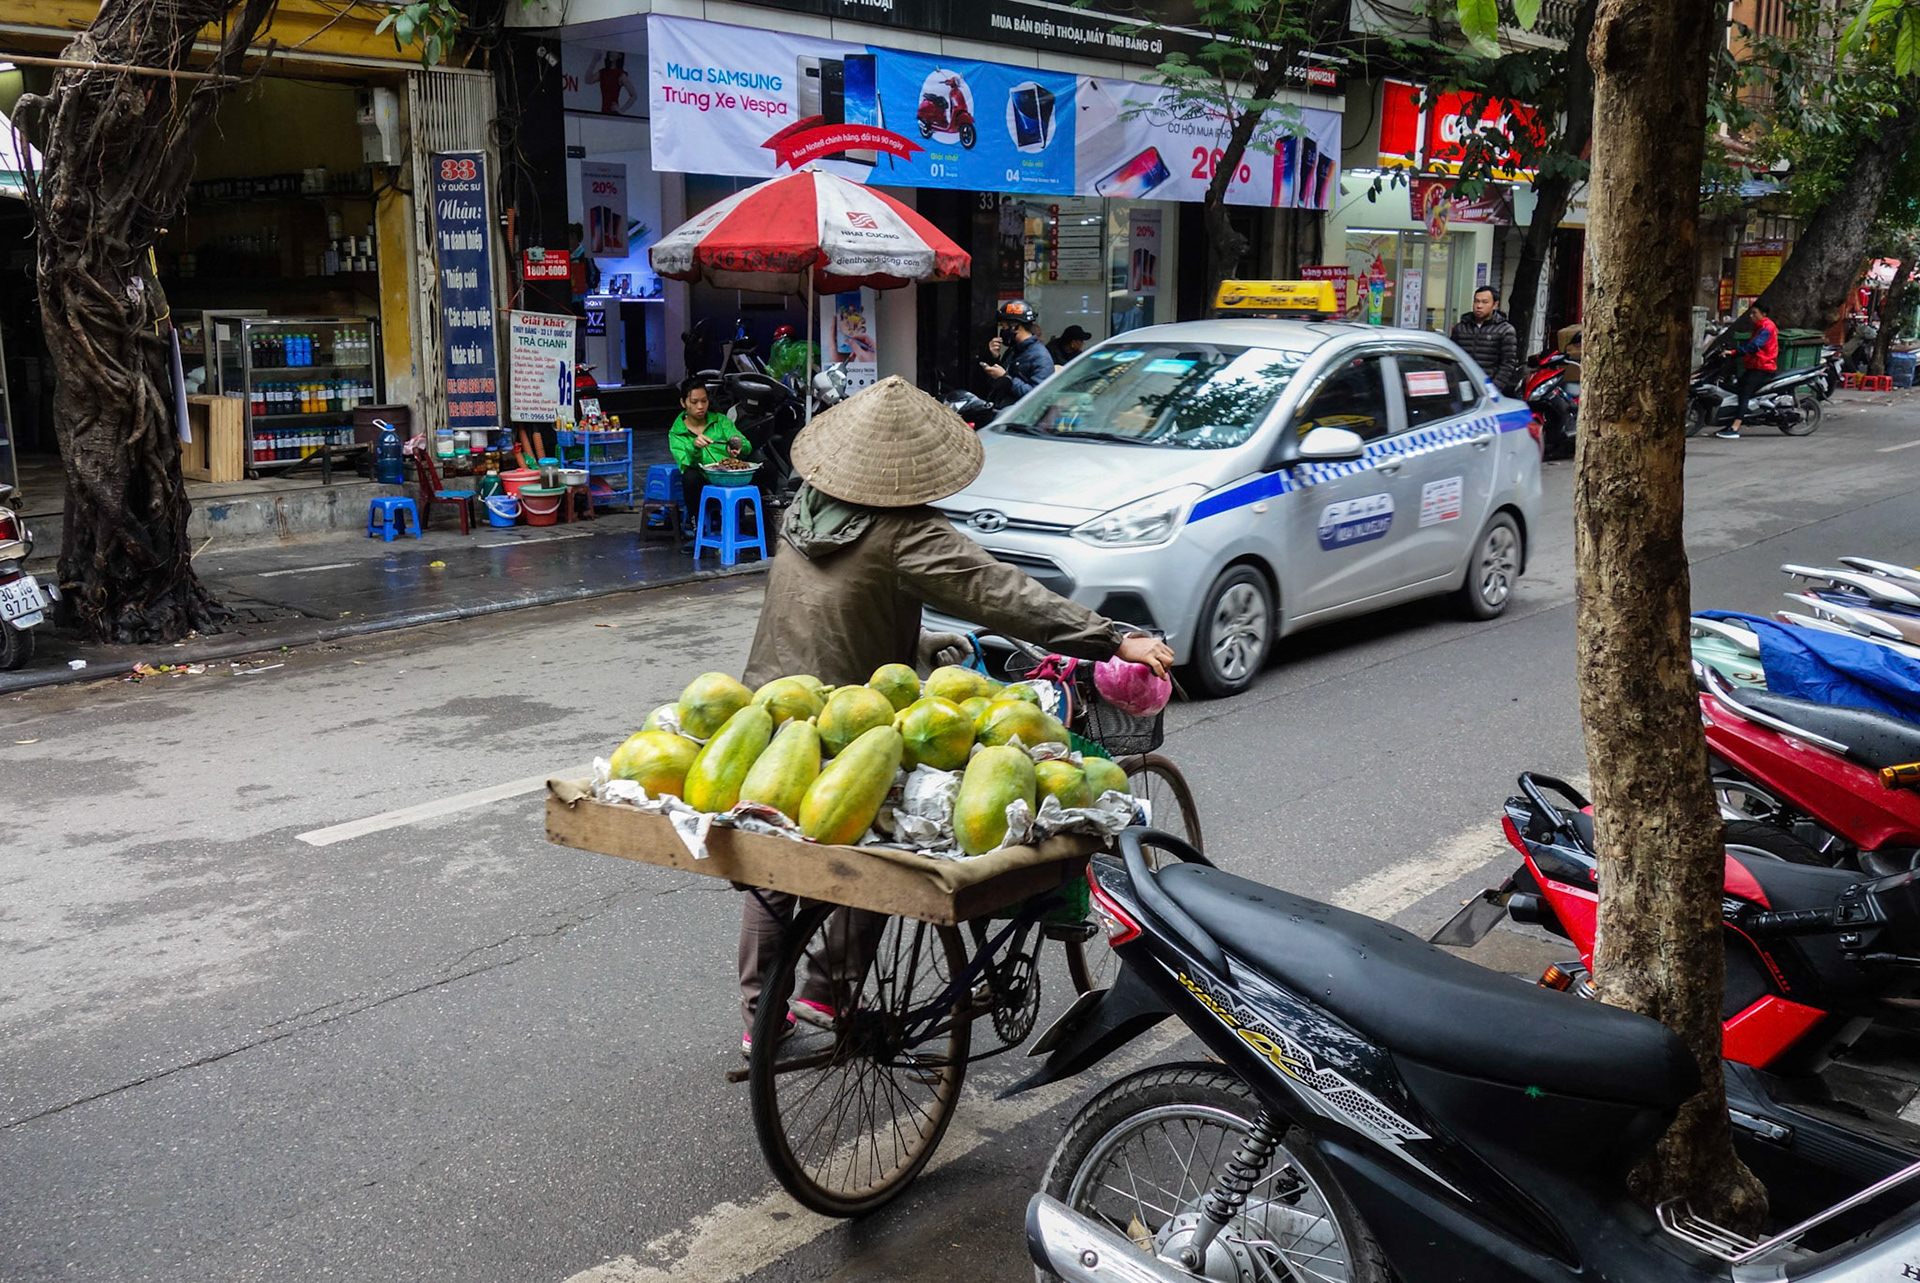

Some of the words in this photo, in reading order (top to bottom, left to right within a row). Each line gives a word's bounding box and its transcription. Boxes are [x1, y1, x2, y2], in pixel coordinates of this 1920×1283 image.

[991, 14, 1012, 30] MUA
[1014, 15, 1033, 33] BÁN
[1034, 19, 1055, 39] ĐIỆN
[1150, 39, 1163, 54] CŨ
[667, 62, 703, 82] Mua
[707, 67, 783, 91] SAMSUNG
[662, 86, 710, 112] Trúng
[715, 92, 736, 109] Xe
[740, 95, 787, 118] Vespa
[1168, 122, 1180, 134] CƠ
[1181, 123, 1196, 138] HỘI
[1196, 127, 1214, 138] MUA
[791, 148, 806, 159] Mua
[805, 139, 825, 152] Note8
[825, 134, 843, 146] chính
[880, 136, 889, 144] 90
[889, 138, 904, 150] ngày
[440, 159, 477, 181] 33
[930, 163, 944, 177] 01
[1006, 169, 1020, 182] 04
[437, 182, 447, 192] LÝ
[448, 181, 469, 191] QUỐC
[470, 182, 481, 191] SƯ
[592, 181, 617, 195] 20%
[979, 192, 994, 210] 33
[438, 199, 482, 225] Nhận:
[450, 230, 466, 250] danh
[466, 227, 483, 252] thiếp
[1136, 226, 1155, 238] 20%
[446, 265, 463, 291] Thiếp
[526, 265, 567, 276] 1800-6009
[448, 307, 461, 327] Các
[461, 306, 477, 329] công
[477, 306, 491, 330] việc
[521, 315, 540, 326] Giải
[543, 317, 565, 328] khát
[587, 311, 604, 326] XZ
[518, 335, 536, 346] TRÀ
[537, 338, 567, 349] CHANH
[451, 345, 467, 364] khác
[467, 341, 475, 364] về
[475, 345, 483, 364] in
[5, 594, 40, 616] 9721
